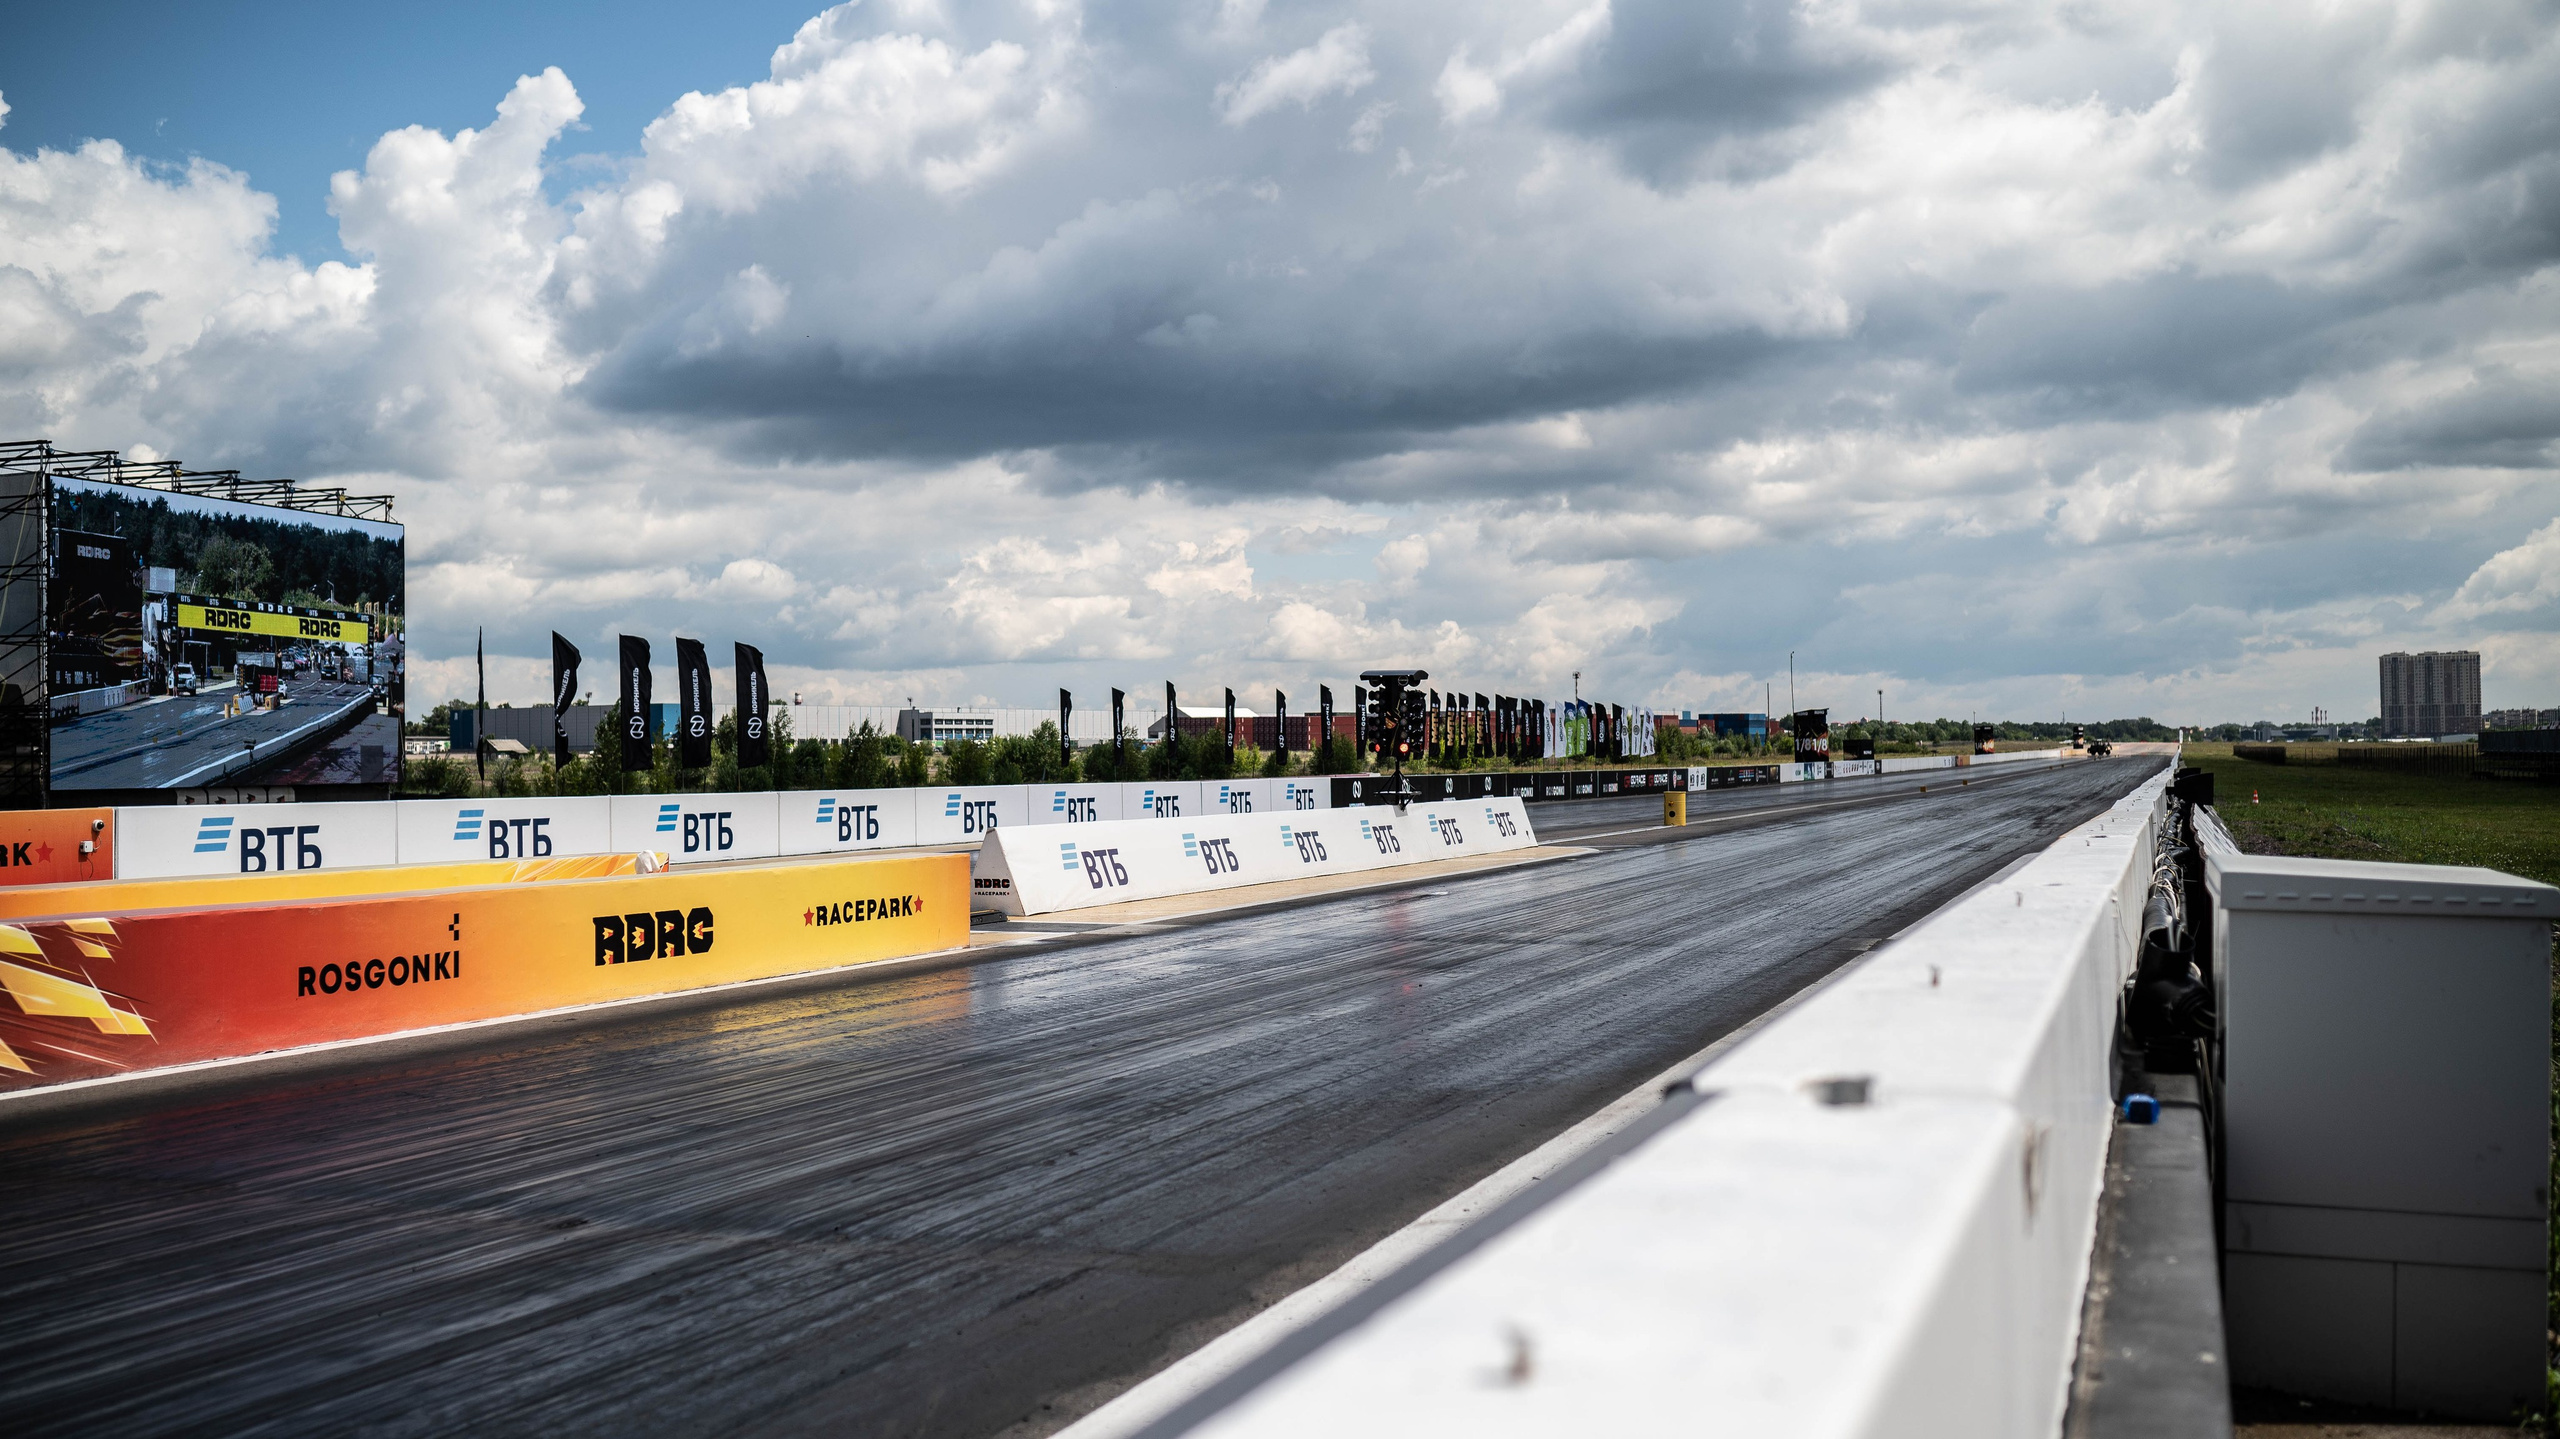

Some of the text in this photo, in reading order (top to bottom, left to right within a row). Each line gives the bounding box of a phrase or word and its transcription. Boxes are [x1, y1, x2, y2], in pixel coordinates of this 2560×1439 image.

[77, 544, 111, 560] RDRC
[204, 608, 252, 630] RDRC
[299, 618, 341, 638] RDRC
[632, 667, 640, 713] НОРНИКЕЛЬ
[692, 668, 700, 712] НОРНИКЕЛЬ
[750, 671, 758, 714] НОРНИКЕЛЬ
[1795, 738, 1811, 753] 1/8
[1813, 738, 1828, 753] 1/8
[1068, 797, 1097, 822] ВТБ
[1156, 795, 1180, 817] ВТБ
[1231, 791, 1252, 813] ВТБ
[1296, 789, 1315, 810] ВТБ
[683, 811, 734, 853] ВТБ
[838, 804, 879, 842] ВТБ
[963, 800, 998, 834] ВТБ
[1438, 818, 1463, 846] ВТБ
[1494, 811, 1517, 838] ВТБ
[240, 824, 322, 873] ВТБ
[488, 817, 552, 858] ВТБ
[1294, 830, 1328, 864] ВТБ
[1372, 825, 1401, 855] ВТБ
[1081, 848, 1129, 890] ВТБ
[1199, 837, 1239, 875] ВТБ
[974, 878, 1010, 889] RDRC
[816, 895, 913, 927] RACEPARK
[592, 906, 714, 967] RDRC
[298, 950, 460, 997] ROSGONKI
